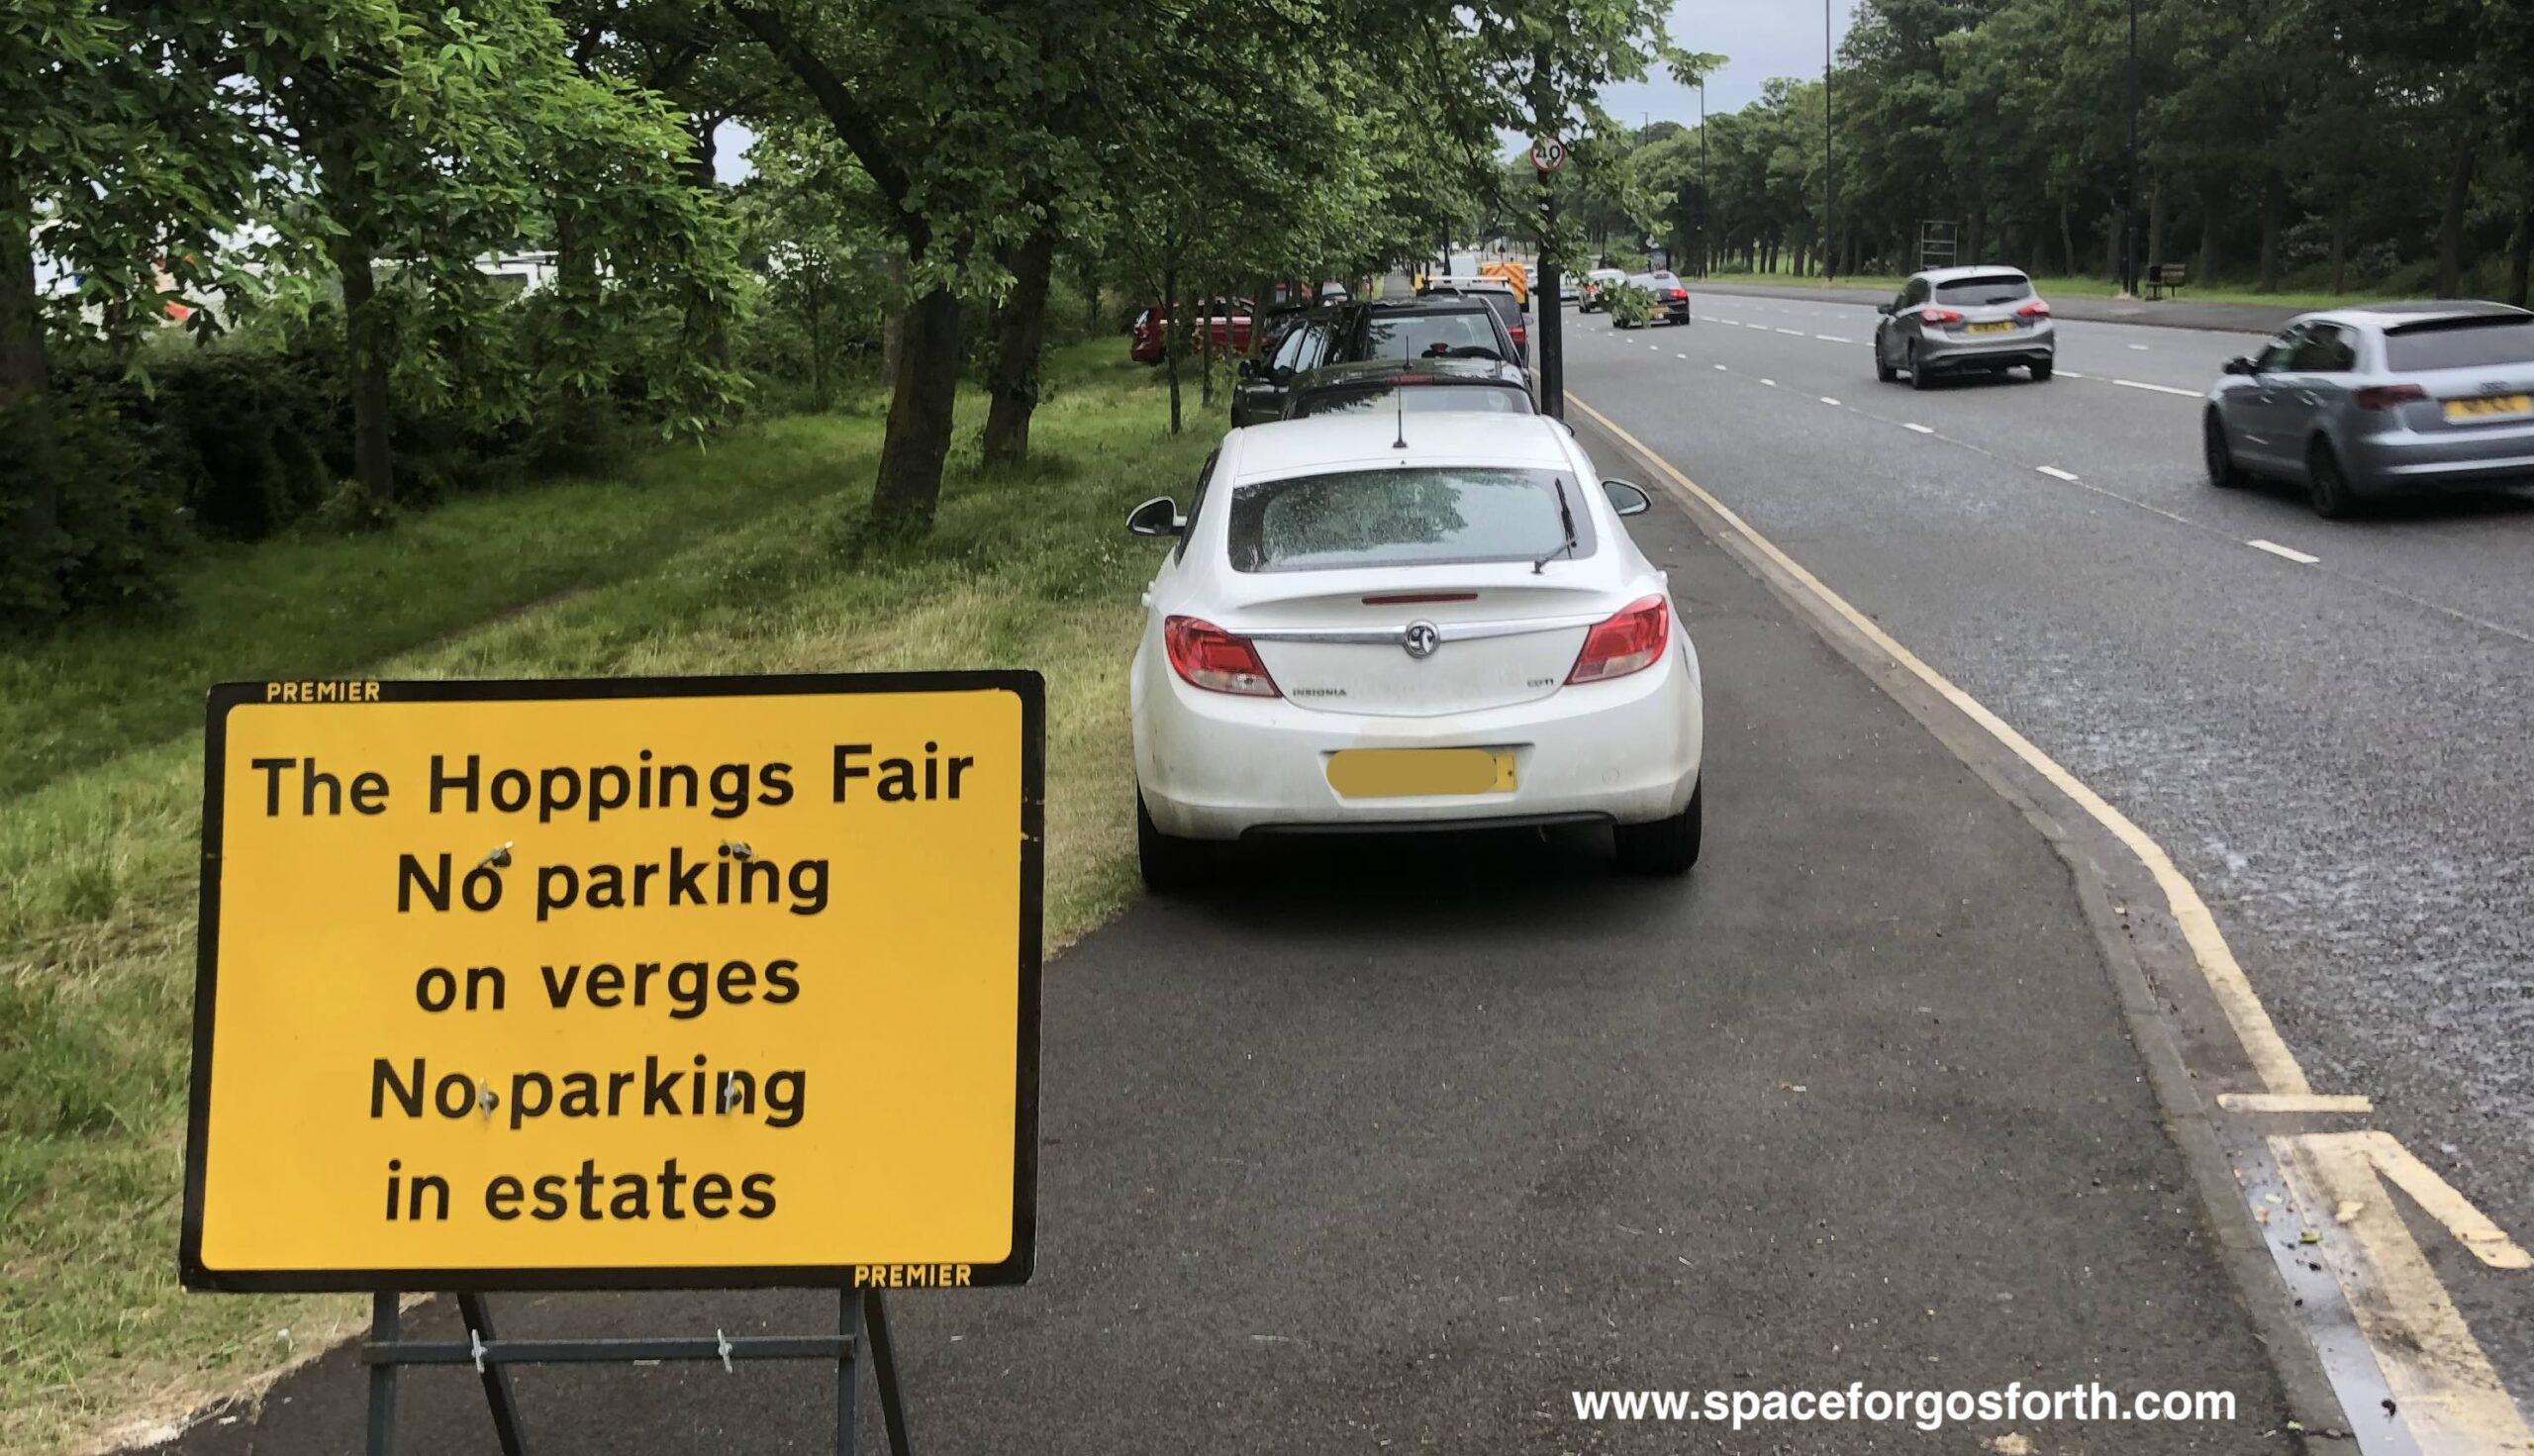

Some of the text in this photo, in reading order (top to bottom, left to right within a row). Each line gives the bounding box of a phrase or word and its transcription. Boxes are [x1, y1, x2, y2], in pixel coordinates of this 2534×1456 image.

[266, 681, 381, 702] PREMIER
[252, 741, 974, 824] The Hoppings Fair
[398, 845, 829, 922] No parking
[416, 959, 800, 1019] on verges
[370, 1054, 806, 1130] No parking
[386, 1158, 776, 1220] in estates
[853, 1263, 971, 1288] PREMIER
